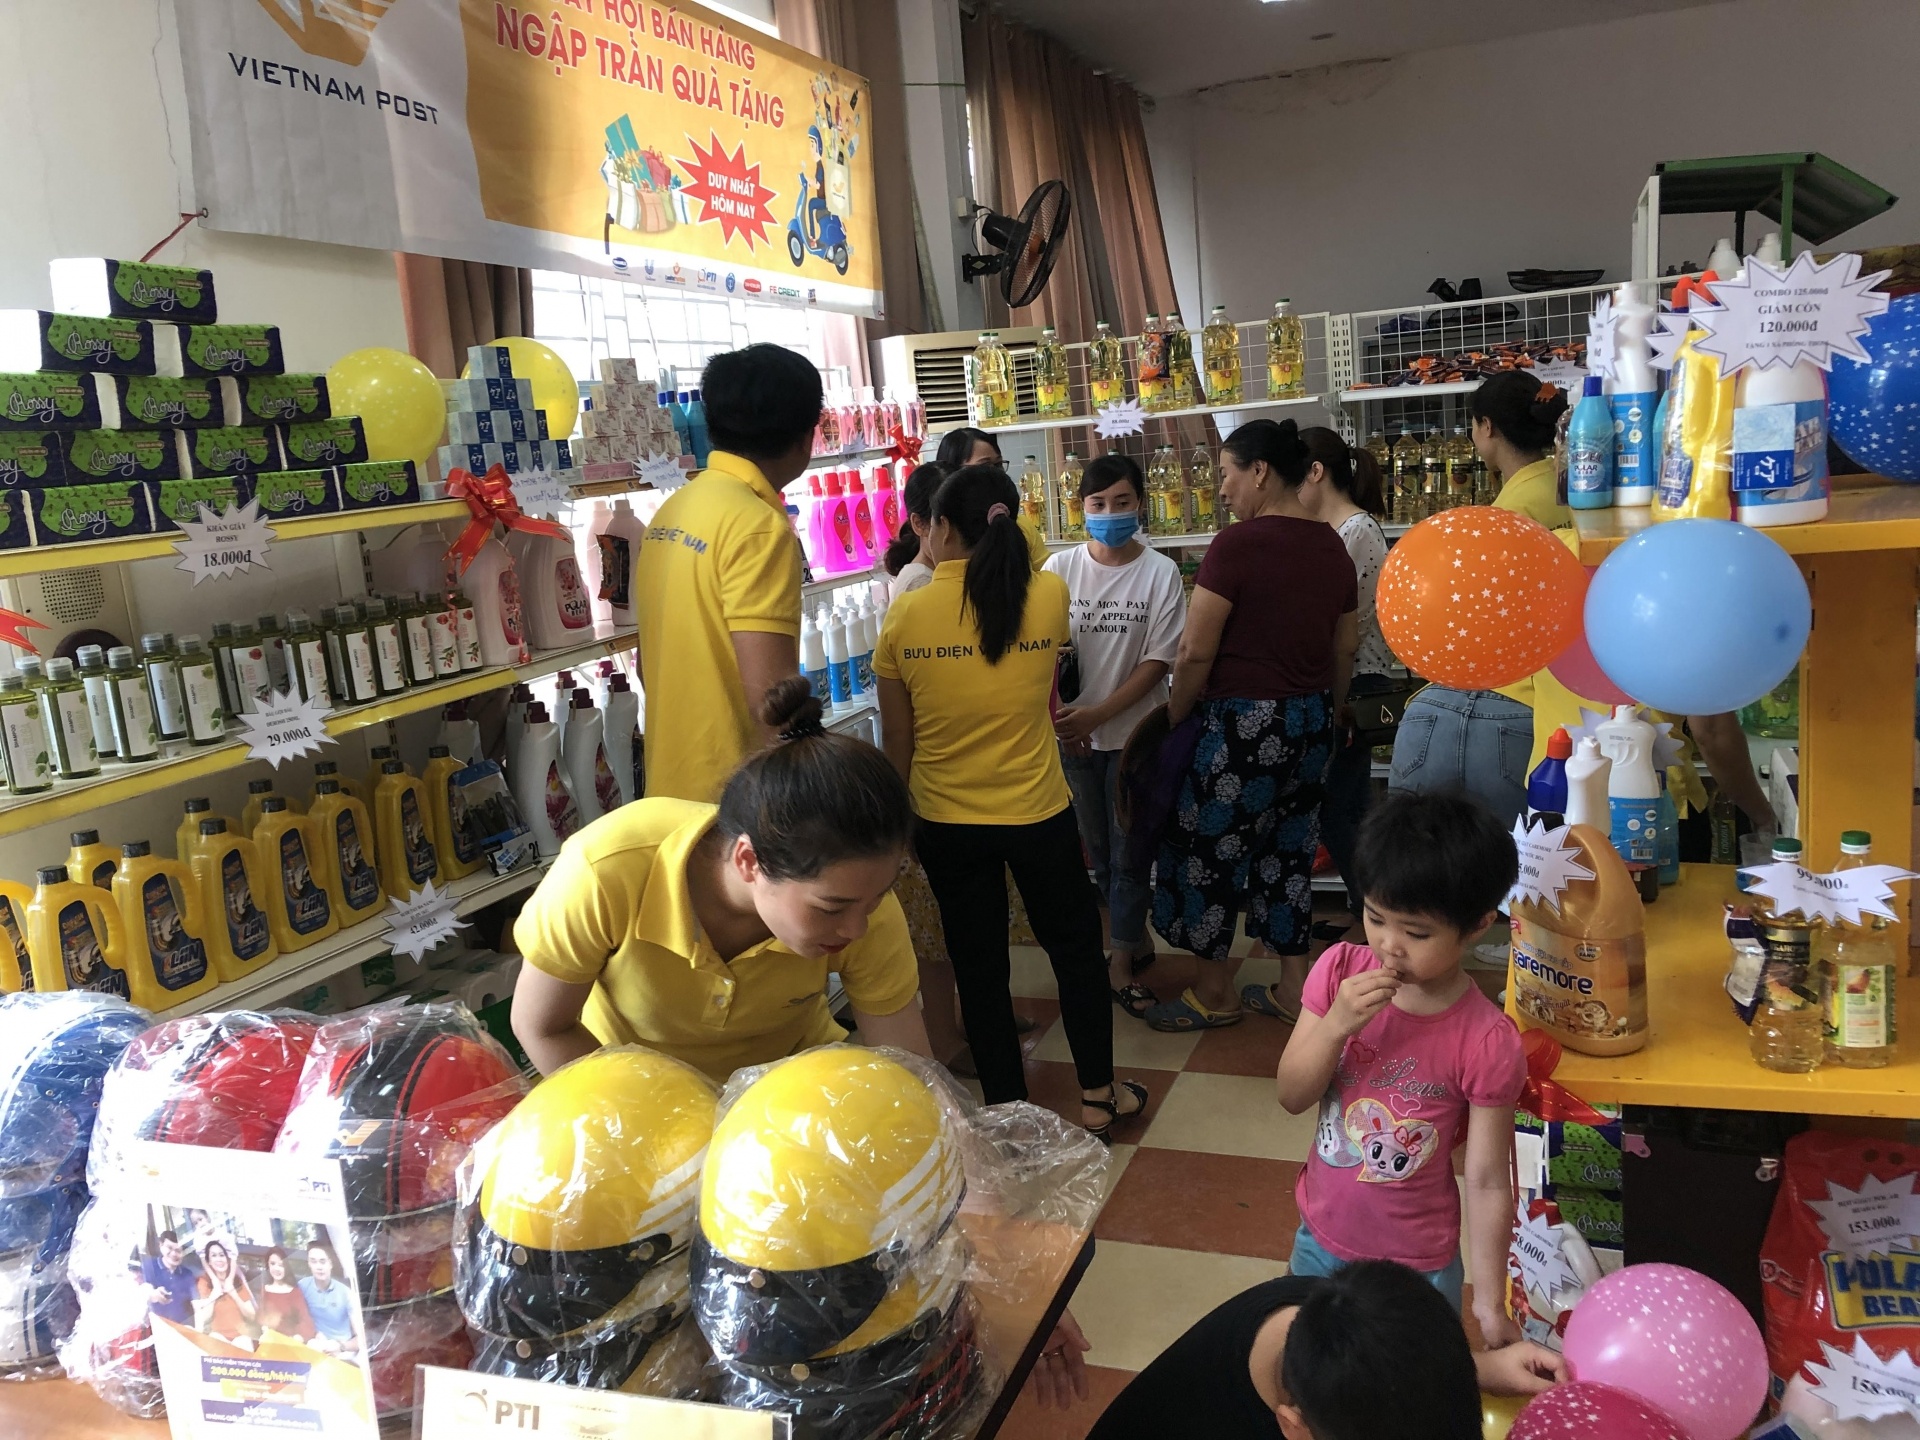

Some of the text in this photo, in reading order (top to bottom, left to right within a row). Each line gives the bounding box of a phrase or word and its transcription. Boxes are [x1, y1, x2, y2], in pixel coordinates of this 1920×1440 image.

[651, 6, 695, 50] BÁN
[700, 24, 755, 71] HÀNG
[496, 3, 785, 130] NGẬP TRÀN QUÀ TẶNG
[228, 52, 438, 124] VIETNAM POST
[708, 170, 755, 198] DUY NHẤT
[711, 193, 756, 219] HÔM NAY
[778, 286, 800, 297] CREDIT
[1754, 288, 1792, 297] COMBO
[1760, 320, 1818, 333] 120.000đ
[9, 392, 58, 423] Rossy
[1097, 600, 1120, 609] MON
[1101, 612, 1149, 624] APPELAIT
[1091, 625, 1128, 634] AMOUR
[904, 647, 931, 660] BƯU
[936, 643, 973, 660] ĐIỆN
[1019, 638, 1051, 653] NAM
[266, 726, 312, 747] 29.000đ
[312, 1181, 331, 1193] PTI
[494, 1400, 540, 1430] PTI
